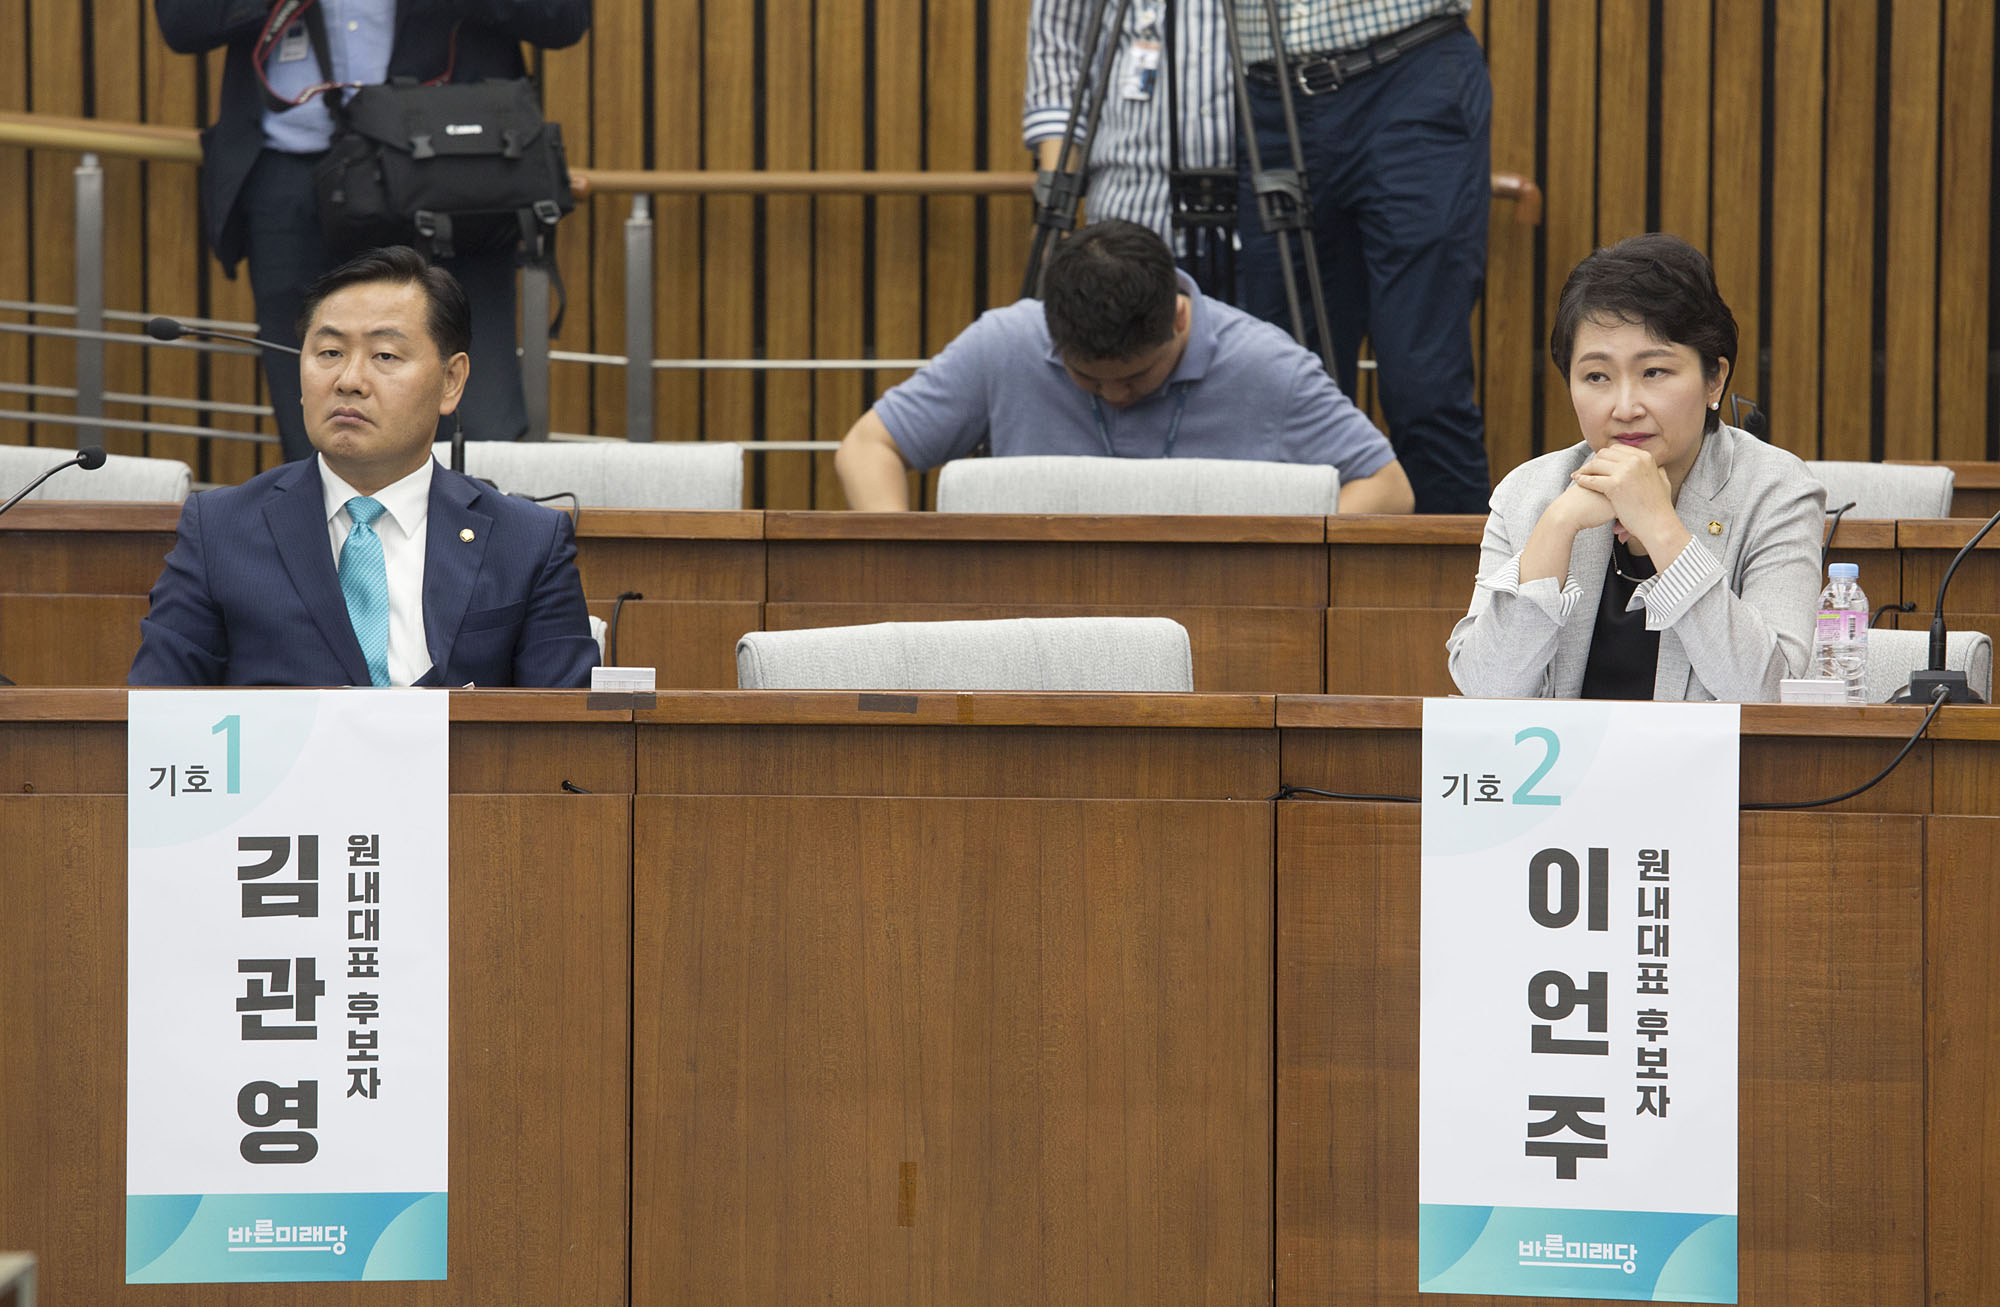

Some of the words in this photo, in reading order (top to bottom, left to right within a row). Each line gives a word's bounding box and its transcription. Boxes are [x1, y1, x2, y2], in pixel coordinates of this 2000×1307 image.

[148, 764, 212, 797] 기호
[212, 715, 241, 794] 1
[1441, 773, 1504, 806] 기호
[1512, 727, 1561, 806] 2
[347, 834, 380, 978] 원내대표
[1636, 849, 1670, 995] 원내대표
[236, 834, 326, 1165] 김관영
[346, 991, 381, 1100] 후보자
[1525, 847, 1609, 1180] 이언주
[1636, 1008, 1671, 1118] 후보자
[227, 1219, 348, 1256] 바른미래당
[1518, 1234, 1638, 1274] 바른미래당
